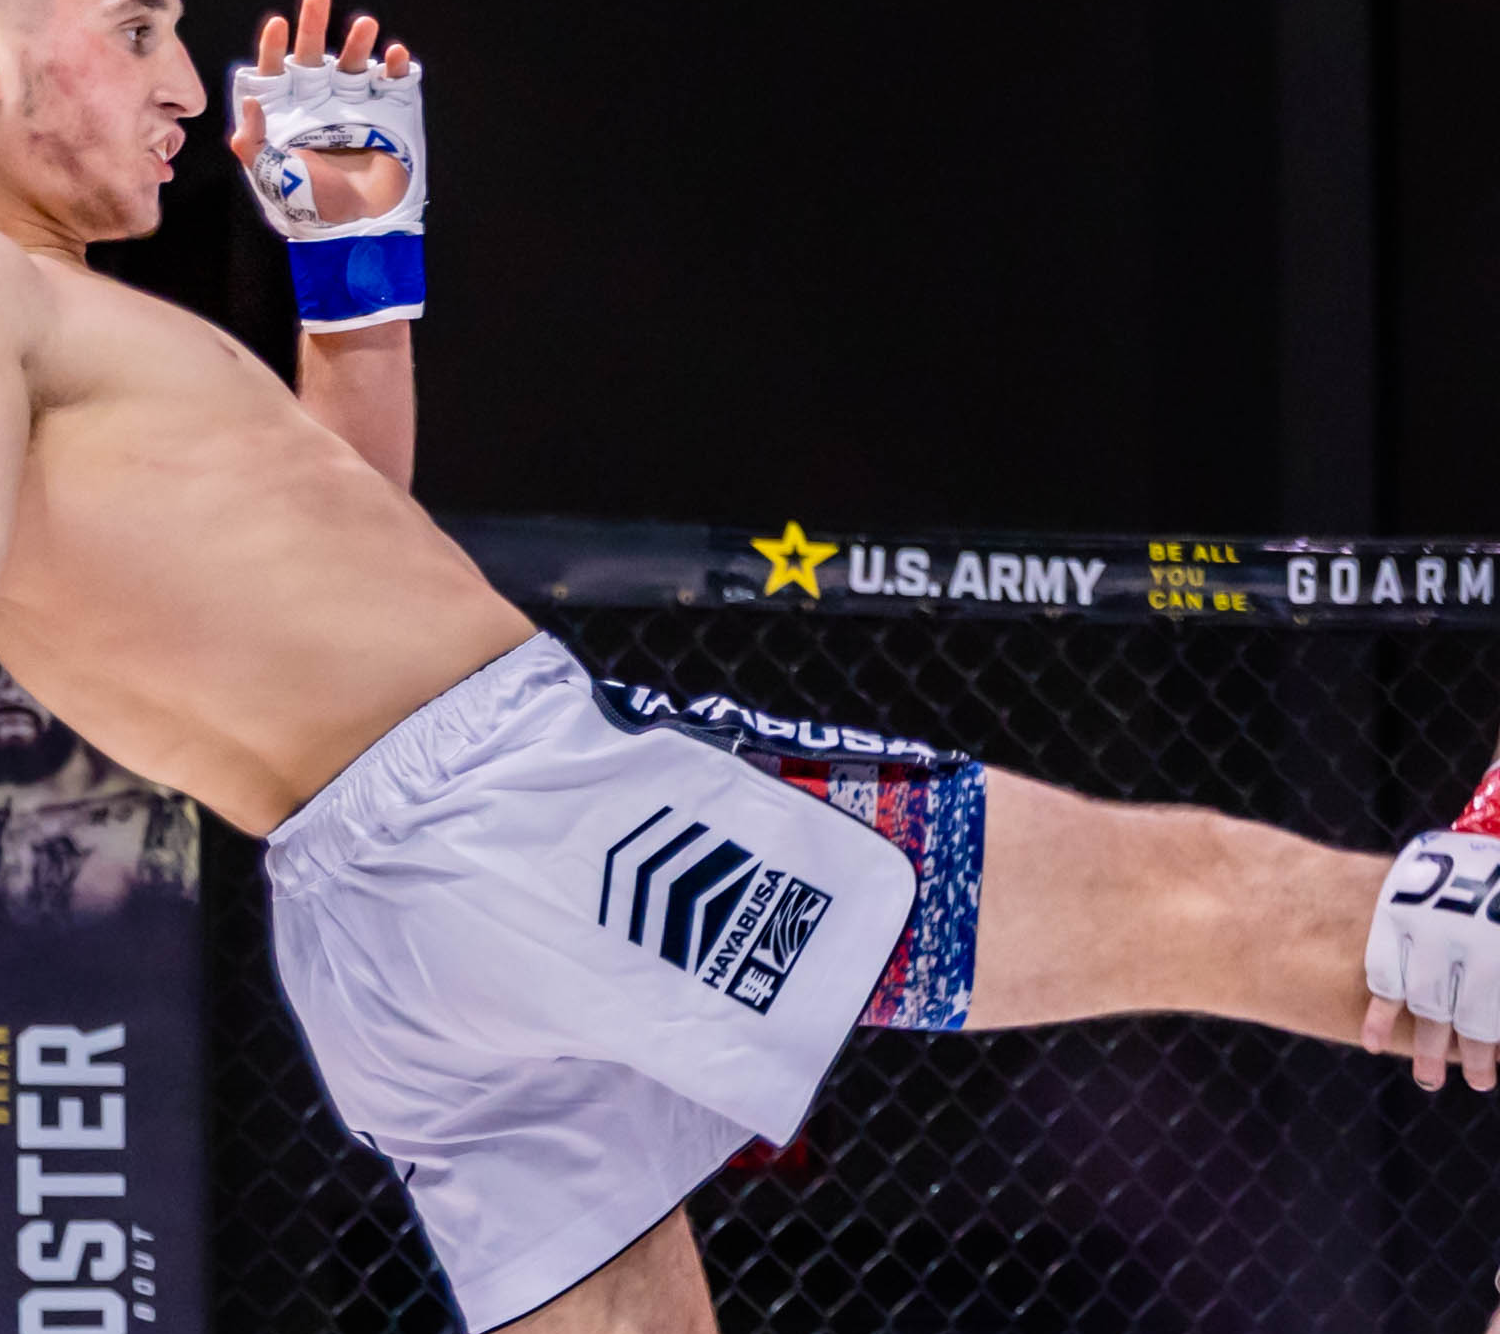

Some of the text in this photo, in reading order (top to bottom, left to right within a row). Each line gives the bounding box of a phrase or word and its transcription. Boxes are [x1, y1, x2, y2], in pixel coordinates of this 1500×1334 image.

[1147, 541, 1242, 564] BE ALL
[846, 544, 1109, 609] U.S. ARMY
[1148, 564, 1206, 587] YOU
[1147, 588, 1205, 611] CAN
[701, 866, 789, 990] HAYABUSA
